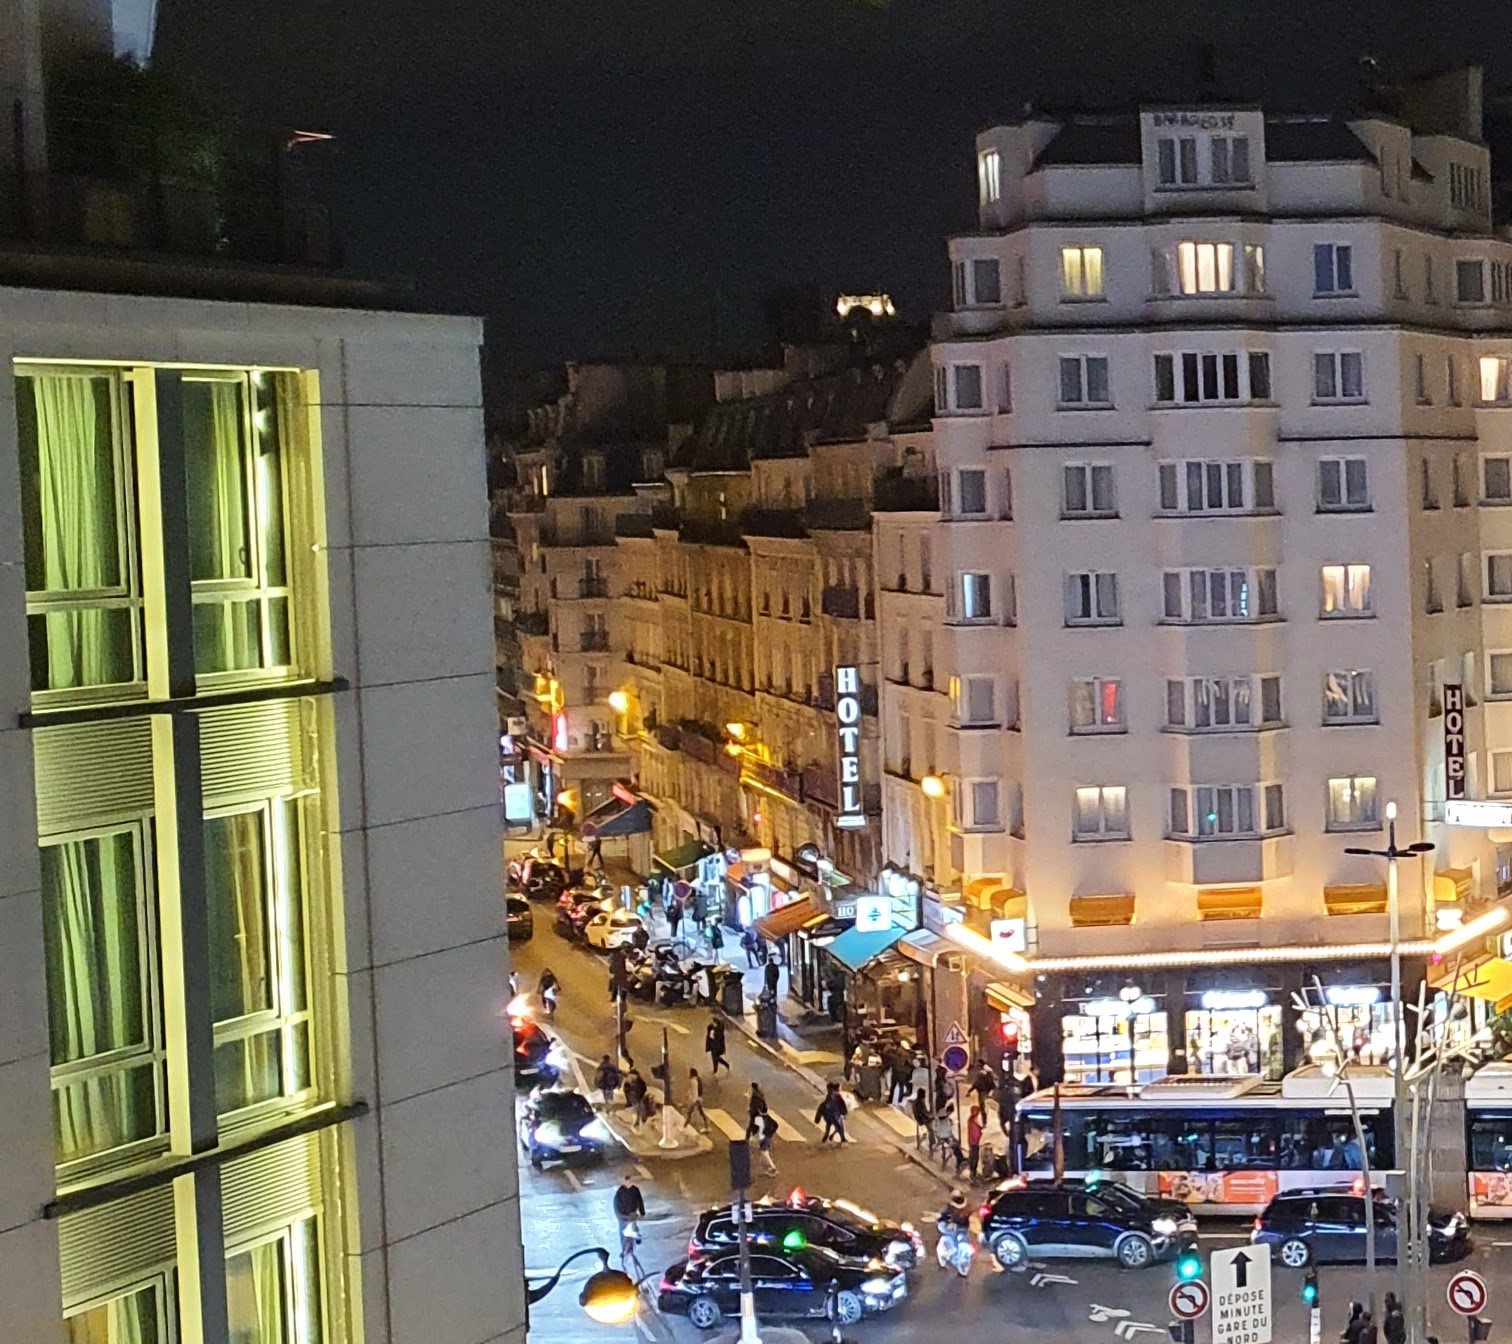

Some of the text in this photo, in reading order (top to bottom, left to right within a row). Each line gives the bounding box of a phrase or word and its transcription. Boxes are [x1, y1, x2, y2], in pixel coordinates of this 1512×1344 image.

[837, 667, 859, 811] HOTEL
[1446, 689, 1464, 799] HOTEL
[1219, 1289, 1264, 1306] DÉPOSE
[1220, 1303, 1264, 1320] MINUTE
[1217, 1316, 1268, 1335] GARE DU
